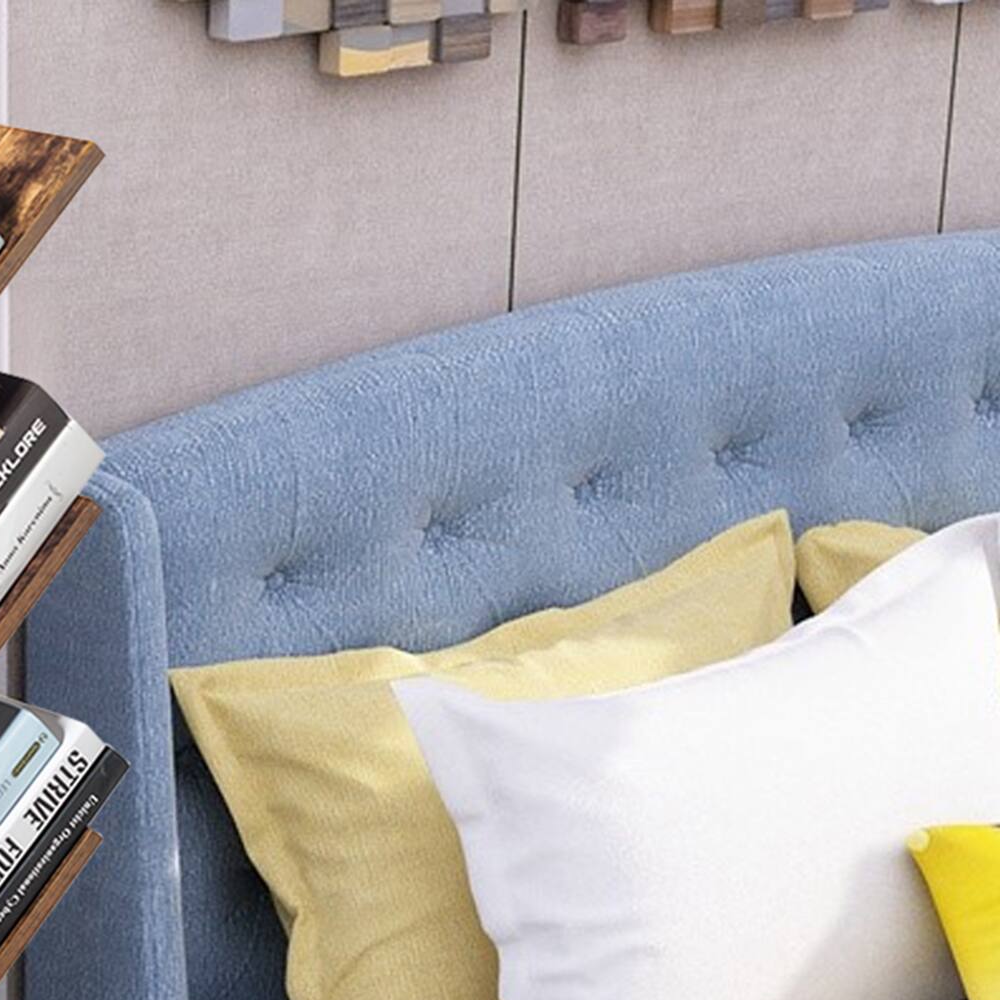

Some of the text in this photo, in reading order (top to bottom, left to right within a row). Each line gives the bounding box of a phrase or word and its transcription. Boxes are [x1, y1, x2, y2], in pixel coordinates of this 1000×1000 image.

[23, 750, 89, 831] STRIVE
[71, 794, 99, 829] Unicist
[23, 830, 72, 892] Organizational
